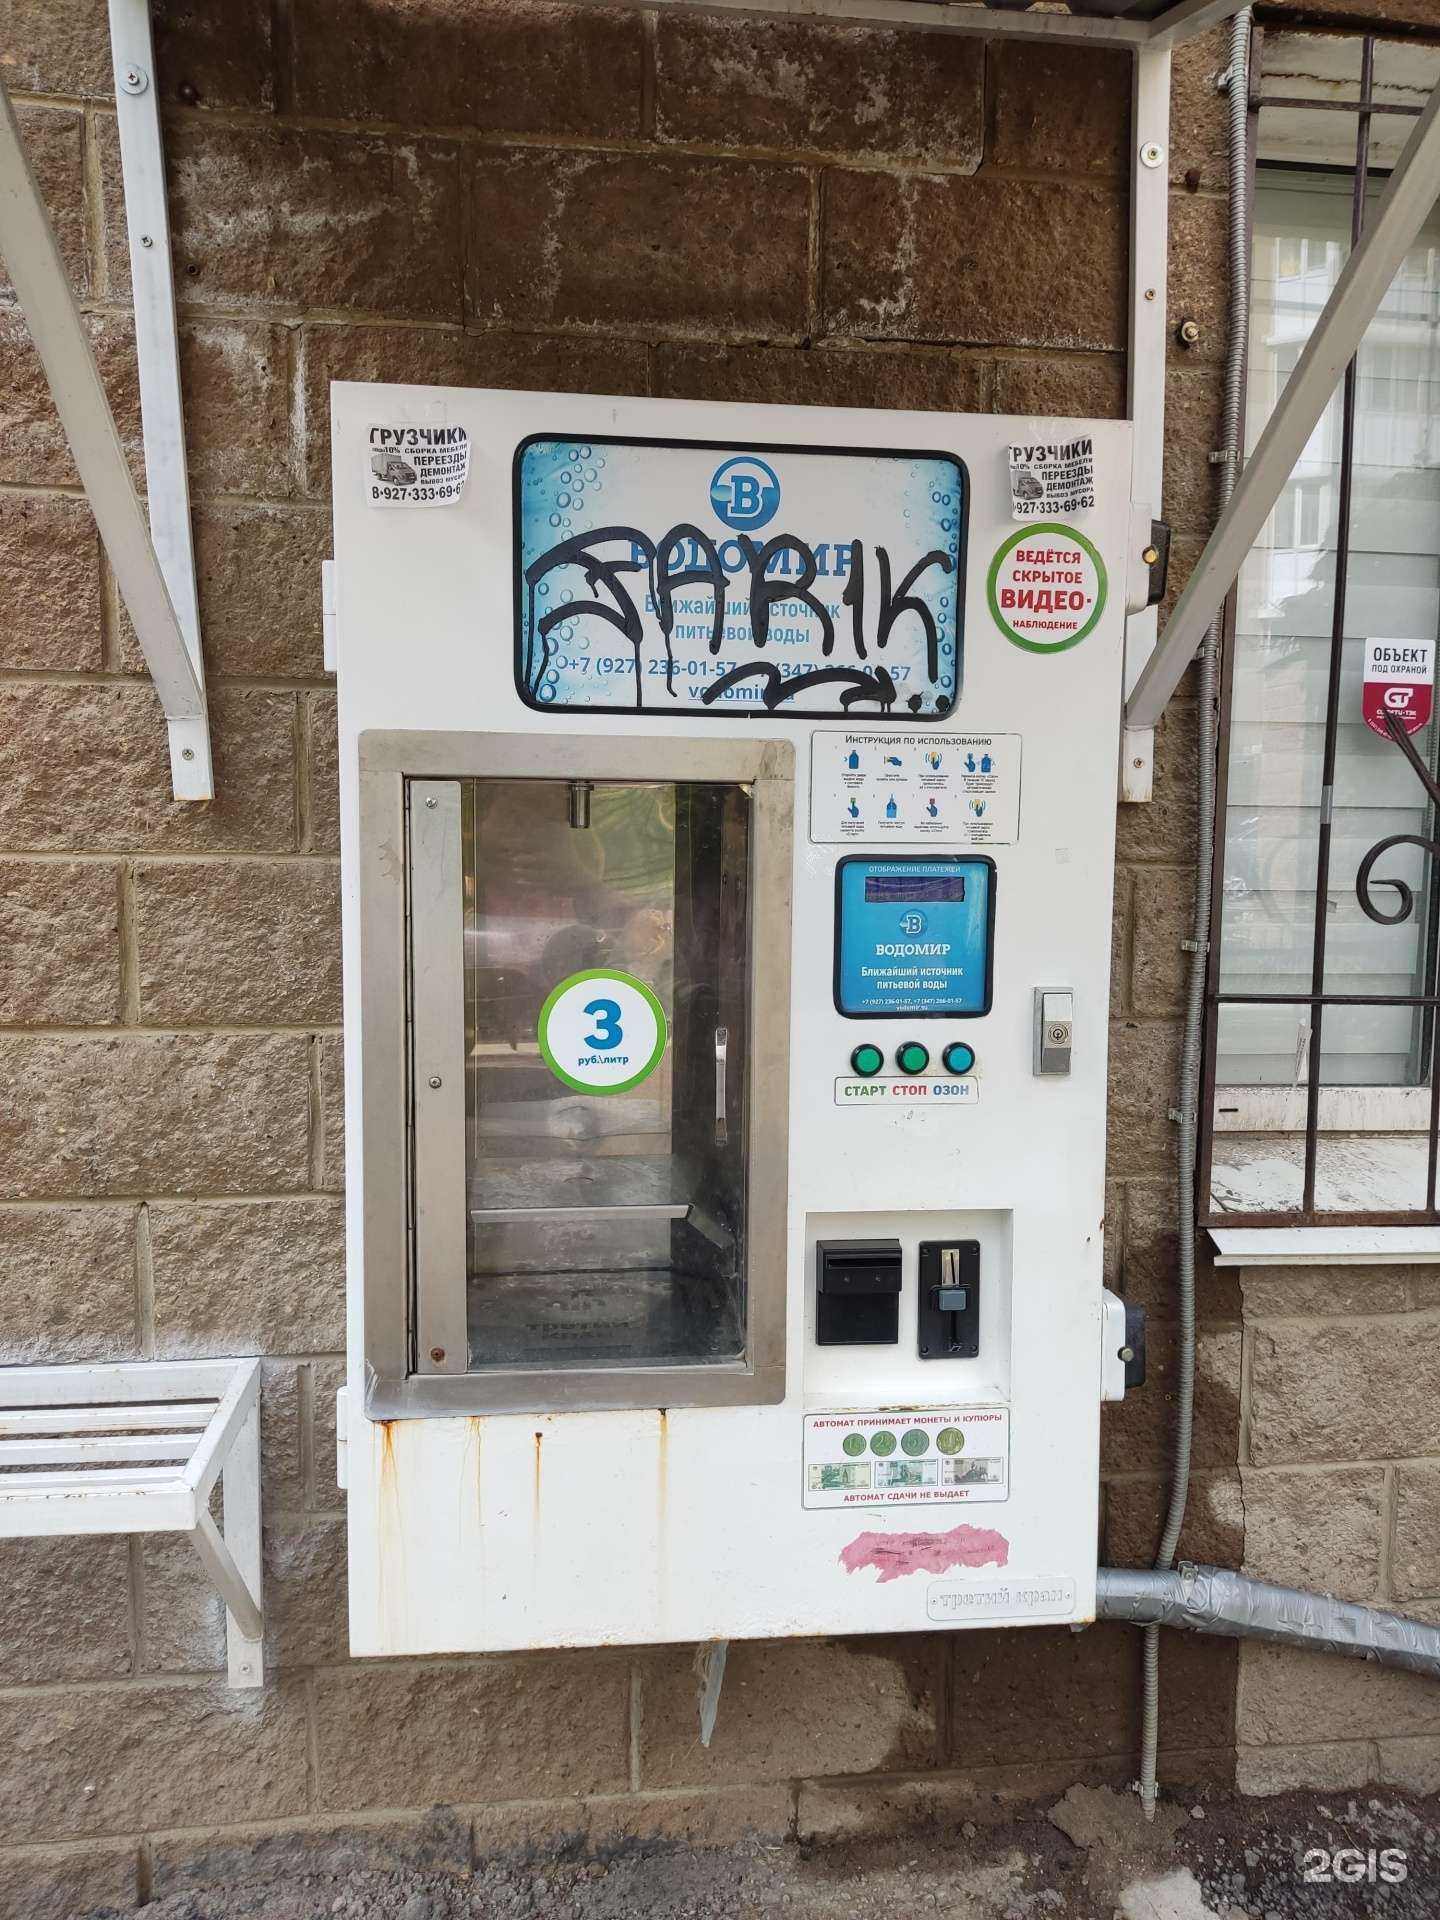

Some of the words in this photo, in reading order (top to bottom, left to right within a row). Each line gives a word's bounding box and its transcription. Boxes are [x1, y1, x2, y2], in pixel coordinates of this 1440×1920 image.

[369, 426, 467, 446] ГРУЗЧИКИ
[1008, 439, 1093, 462] РУЗЧИКИ
[413, 451, 467, 466] ПЕРЕЕЗДЫ
[1064, 458, 1093, 469] МЕБЕЛИ
[420, 463, 466, 478] ДЕМОНТАЖ
[1041, 465, 1093, 481] ПЕРЕЕЗДЫ
[1046, 477, 1094, 491] ДЕМОНТАЖ
[1015, 549, 1081, 565] ВЕДЁТСЯ
[1012, 570, 1083, 584] СКРЫТОЕ
[1012, 620, 1078, 630] НАБЛЮДЕНИЕ
[1373, 647, 1428, 662] ОБЪЕКТ
[568, 657, 591, 673] +7
[1371, 664, 1388, 673] ПОД
[1390, 665, 1427, 674] ОХРАНОЙ
[868, 865, 921, 873] ОТОБРАЖЕНИЕ
[922, 865, 961, 873] ПЛАТЕЖЕЙ
[875, 943, 951, 958] ВОДОМИР
[861, 966, 918, 977] Ближайший
[920, 967, 964, 976] источник
[877, 978, 920, 989] питьевой
[922, 980, 948, 990] воды
[583, 998, 623, 1050] 3
[844, 1085, 887, 1097] СТАРТ
[892, 1084, 927, 1096] СТОП
[933, 1084, 970, 1096] ОЗОН
[813, 1419, 855, 1428] АВТОМАТ
[857, 1417, 911, 1426] ПРИНИМАЕТ
[913, 1415, 951, 1425] МОНЕТЫ
[953, 1415, 961, 1423] И
[962, 1414, 1002, 1423] КУПЮРЫ
[843, 1493, 885, 1502] АВТОМАТ
[887, 1491, 917, 1501] СДАЧИ
[919, 1490, 931, 1499] НЕ
[933, 1489, 970, 1499] ВЫДАЕТ
